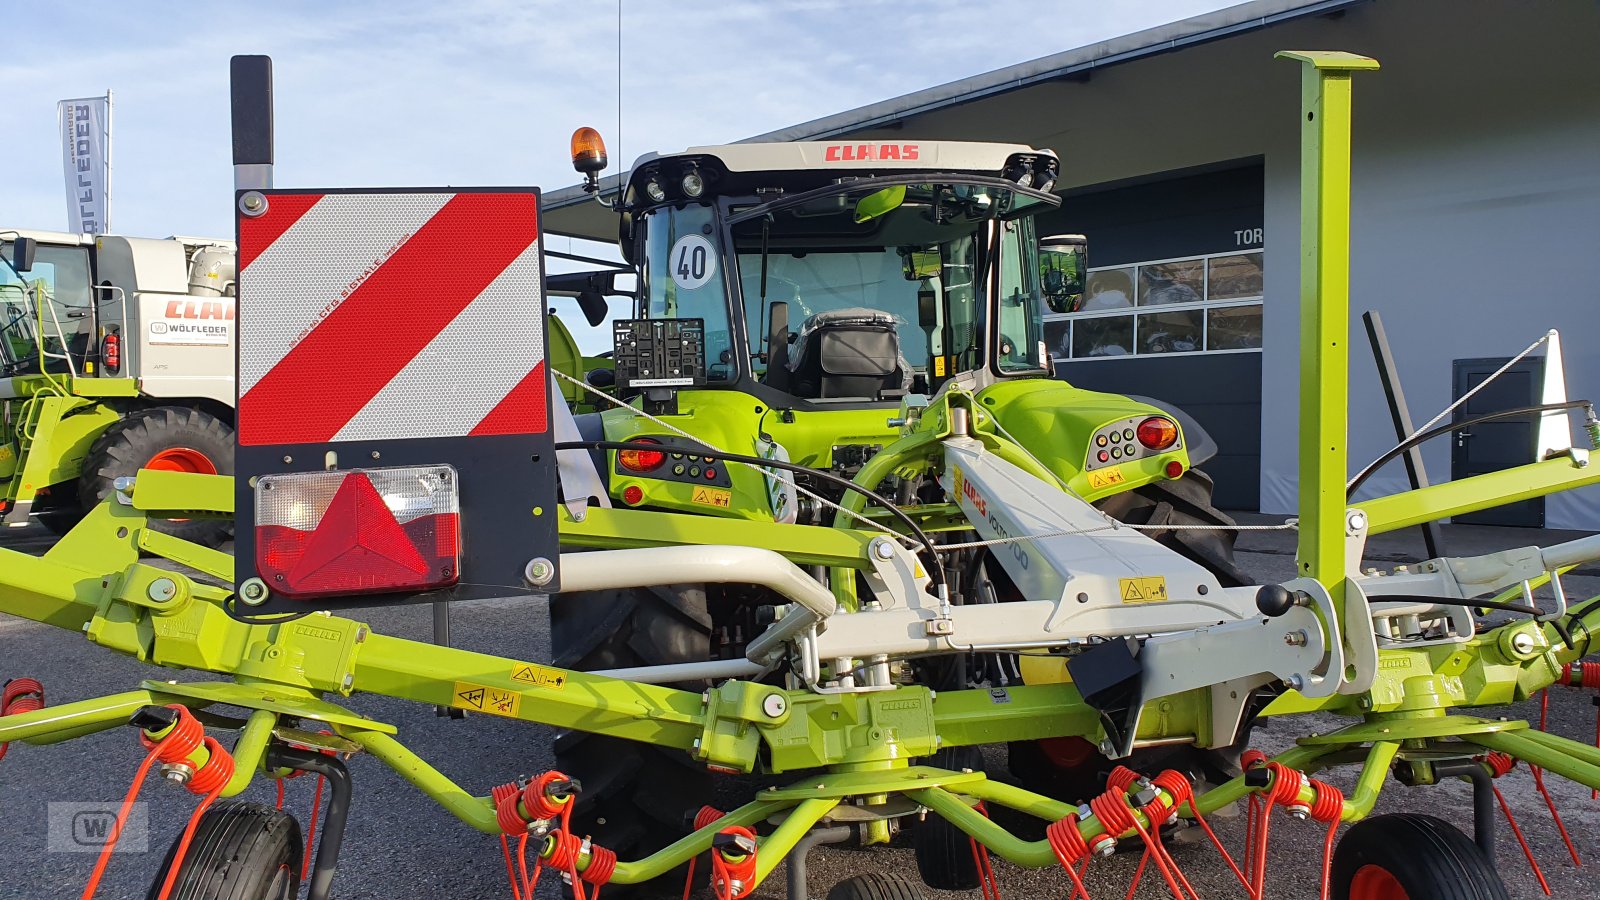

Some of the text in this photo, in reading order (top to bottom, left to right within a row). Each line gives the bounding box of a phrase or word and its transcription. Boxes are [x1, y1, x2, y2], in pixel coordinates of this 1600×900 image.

[825, 144, 919, 161] CLAAS
[1234, 228, 1263, 246] TOR
[677, 245, 706, 280] 40
[319, 258, 382, 318] CFG SIGNALE
[169, 324, 227, 334] WÖLFLEDER
[963, 478, 986, 517] CLAAS
